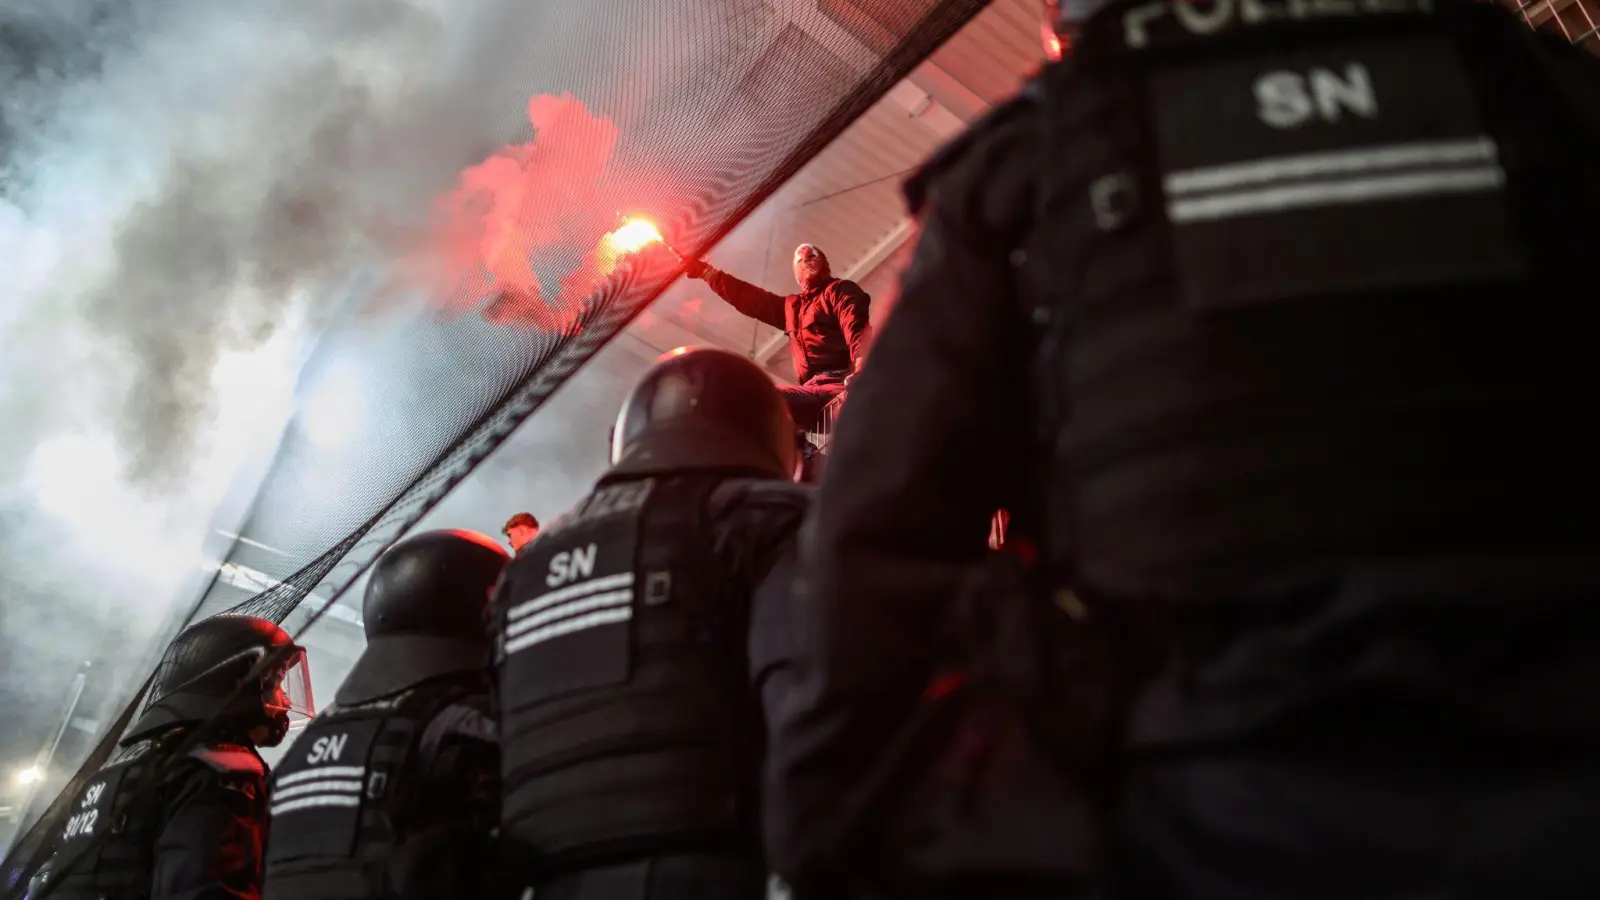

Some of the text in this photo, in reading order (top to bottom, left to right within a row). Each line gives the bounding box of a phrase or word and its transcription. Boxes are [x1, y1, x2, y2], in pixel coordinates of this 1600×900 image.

[1254, 64, 1376, 128] SN
[546, 542, 598, 588] SN
[307, 733, 348, 764] SN
[81, 781, 107, 809] SN
